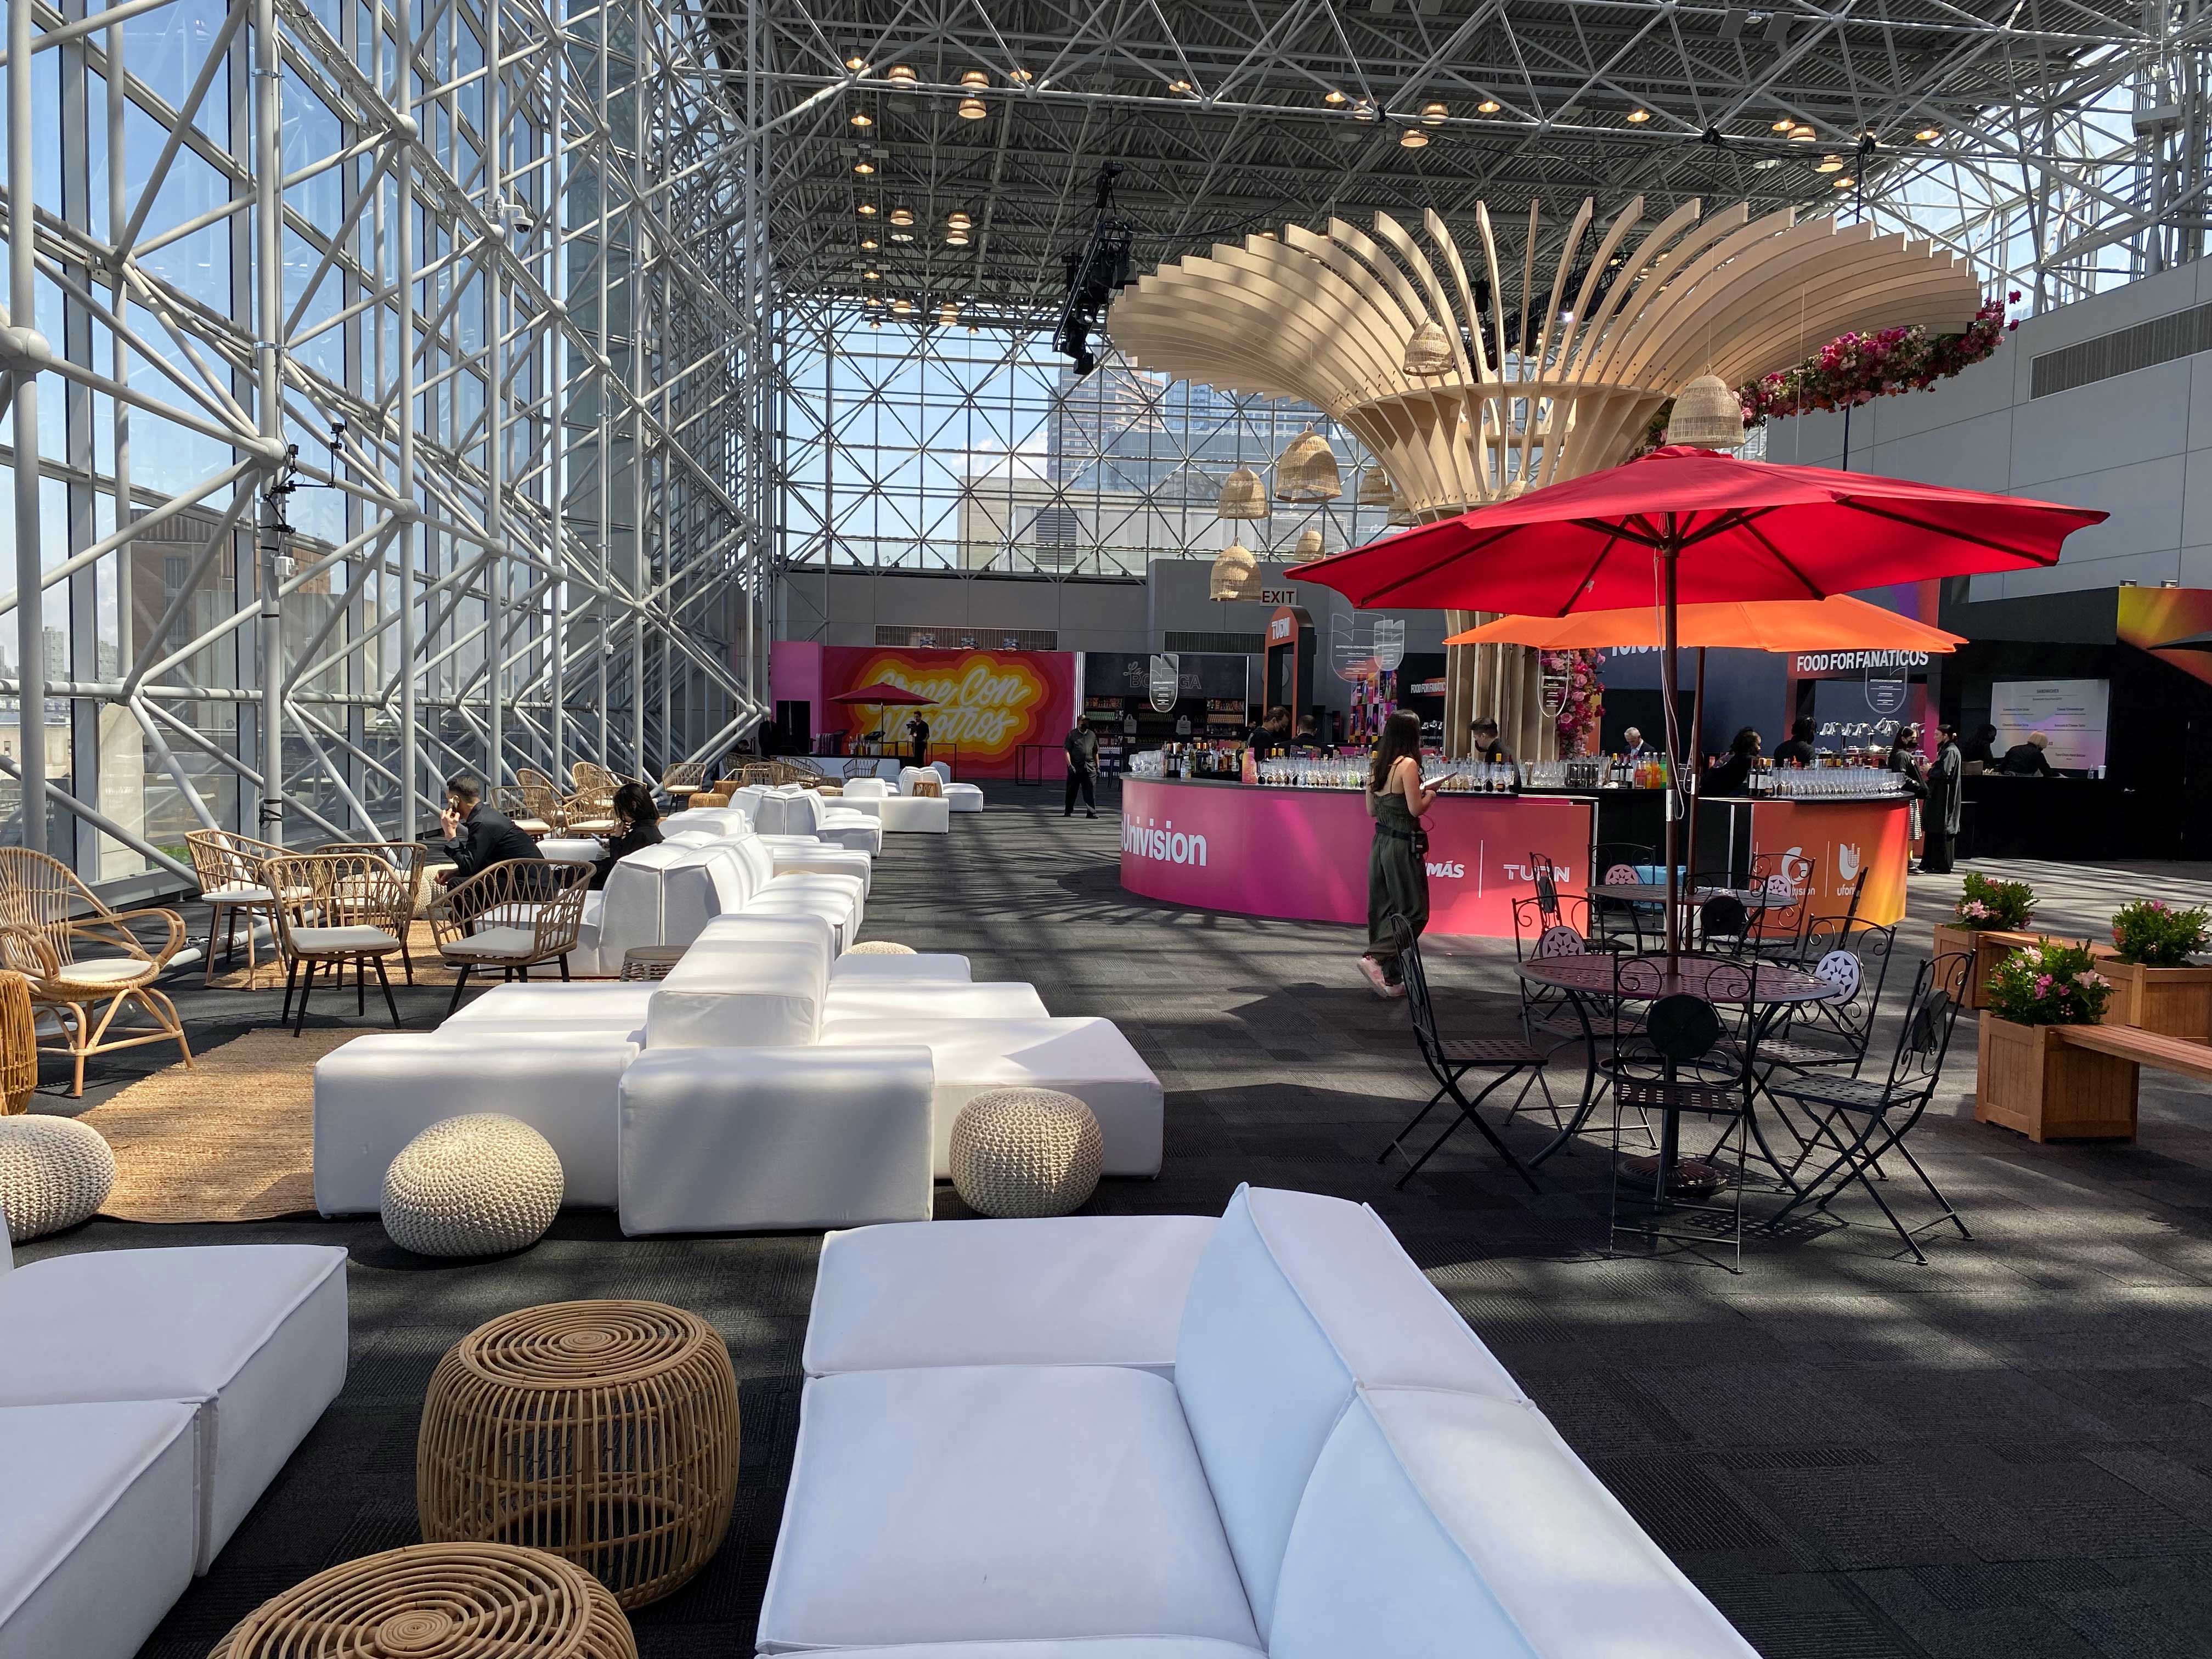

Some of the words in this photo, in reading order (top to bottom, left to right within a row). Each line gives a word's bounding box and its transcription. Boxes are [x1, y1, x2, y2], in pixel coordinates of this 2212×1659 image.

[1262, 591, 1295, 603] EXIT
[1272, 617, 1290, 640] TUDN
[1123, 661, 1144, 676] La
[1797, 654, 1829, 672] FOOD
[1830, 653, 1854, 670] FOR
[961, 668, 1030, 705] Con
[1410, 684, 1421, 694] FOOD
[874, 707, 1019, 744] Nootros
[1121, 812, 1206, 866] Univision
[1425, 860, 1465, 878] MÁS
[1837, 883, 1855, 896] ufori
